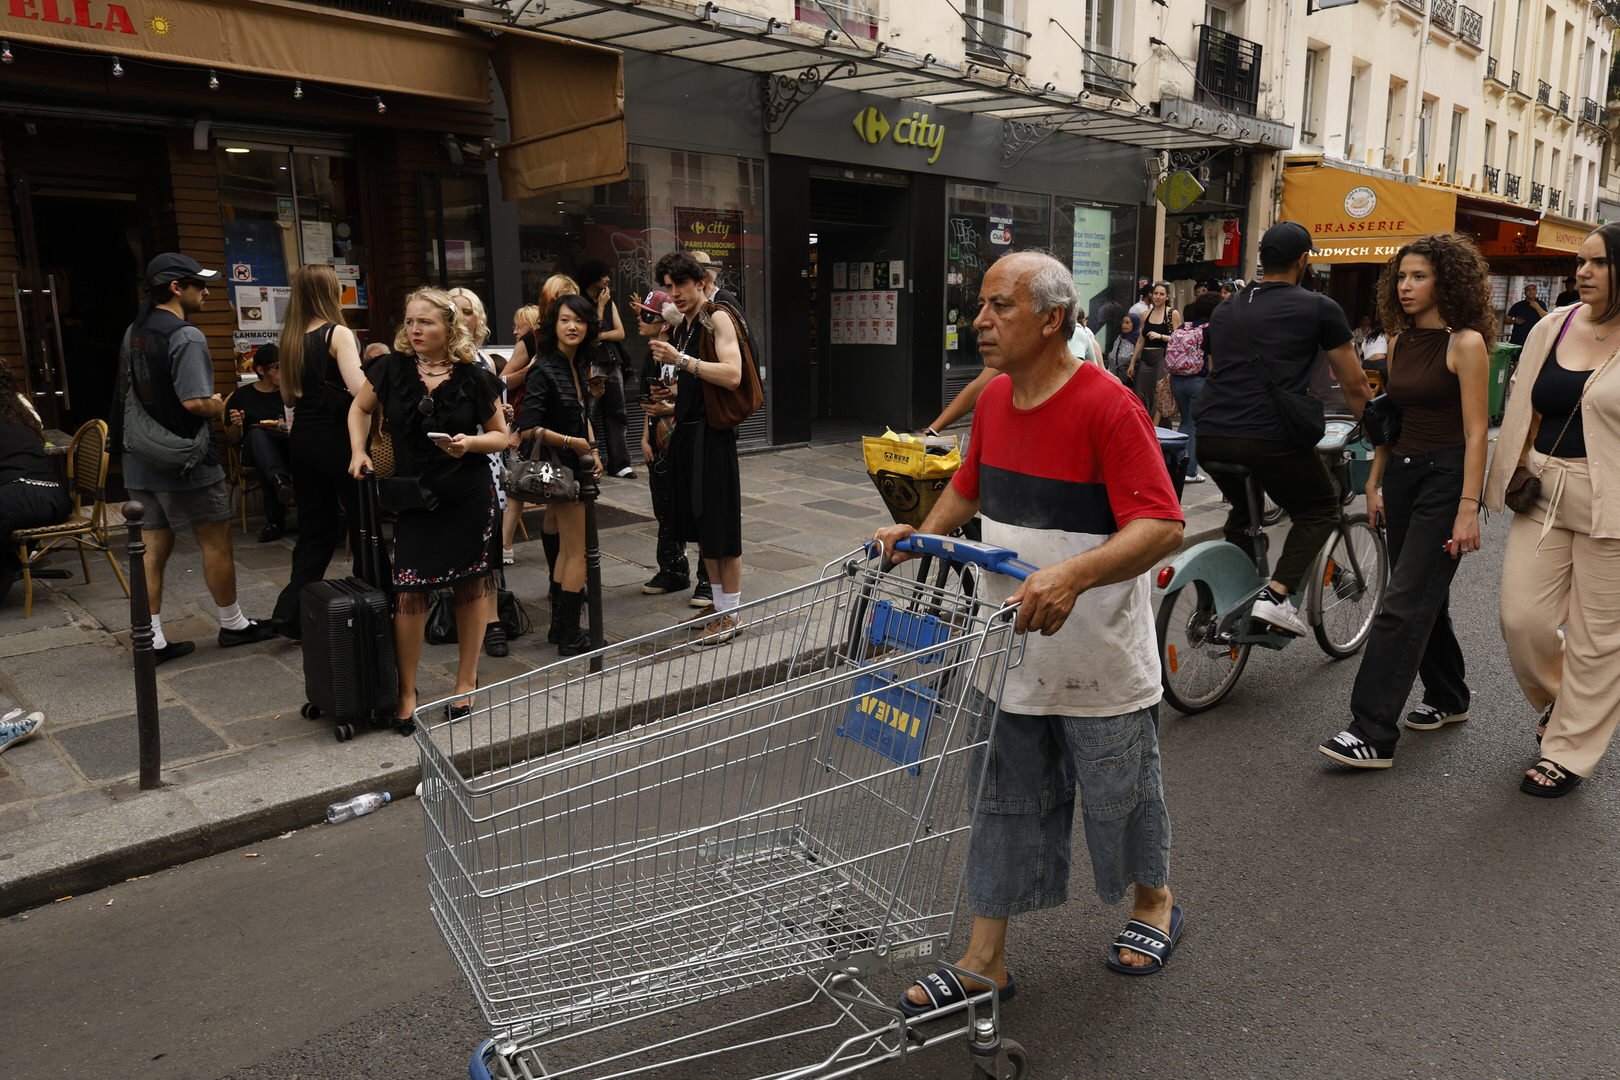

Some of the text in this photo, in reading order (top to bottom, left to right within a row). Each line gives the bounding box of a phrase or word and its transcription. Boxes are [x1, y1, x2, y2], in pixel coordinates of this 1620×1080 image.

[893, 111, 945, 164] city
[707, 221, 730, 240] city
[1314, 220, 1405, 233] BRASSERIE
[703, 241, 736, 249] FAUBOURG
[1308, 247, 1369, 257] ANDWICH
[234, 331, 278, 339] LAHMACUN
[861, 695, 920, 738] IKEA
